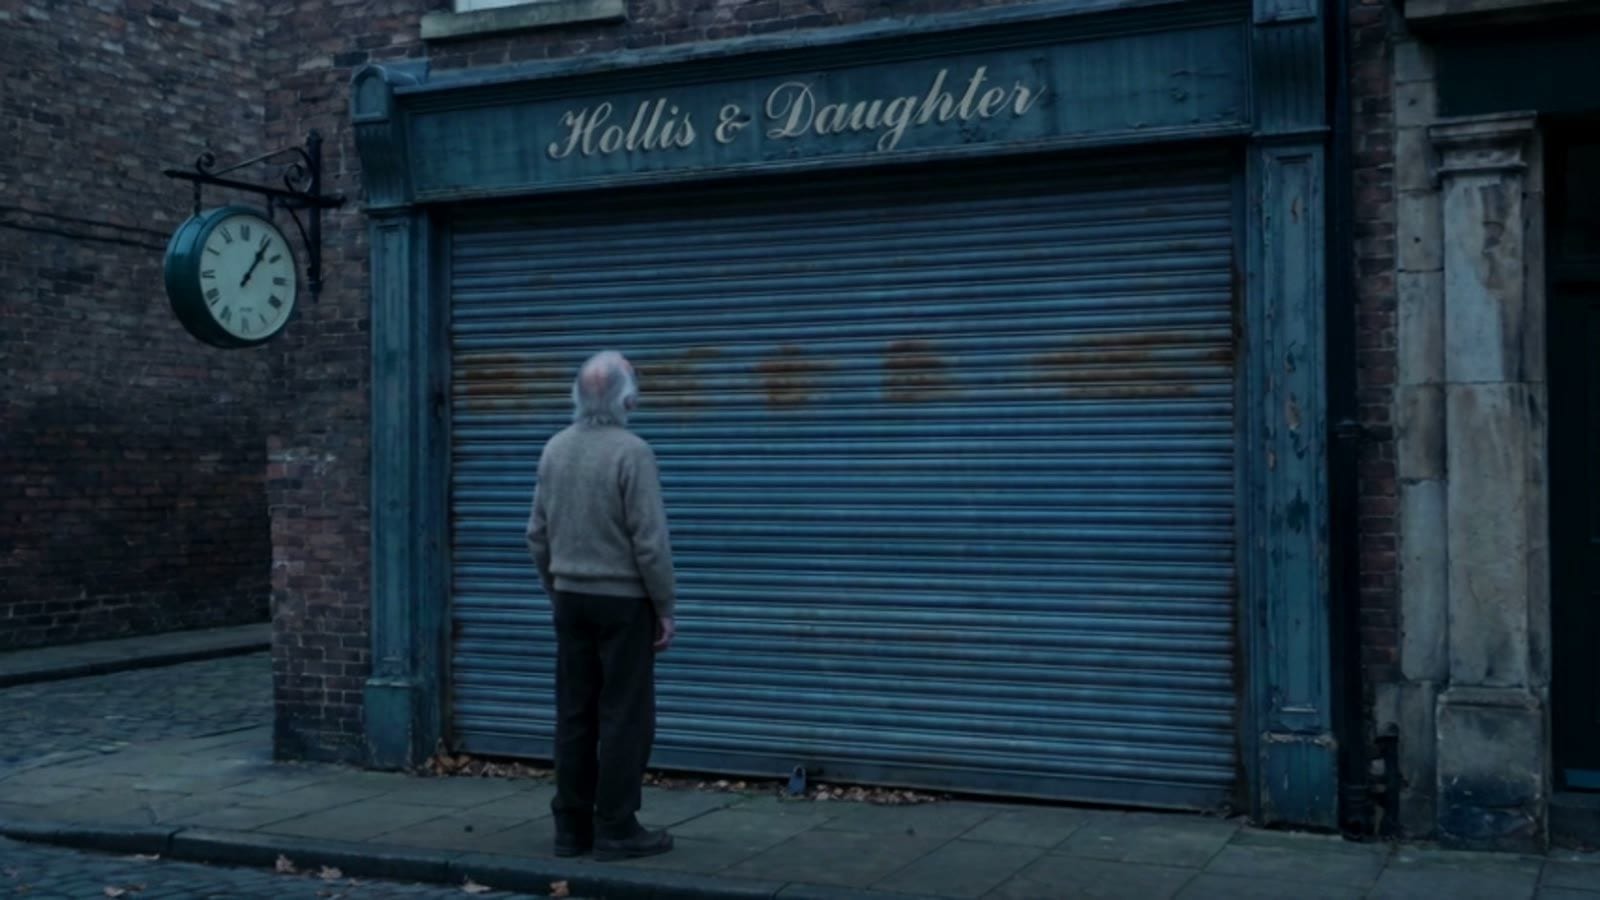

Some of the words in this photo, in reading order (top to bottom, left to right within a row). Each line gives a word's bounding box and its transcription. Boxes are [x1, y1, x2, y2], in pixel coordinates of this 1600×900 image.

[548, 98, 696, 159] Hollis
[715, 104, 751, 143] &
[766, 66, 1047, 151] Daughter
